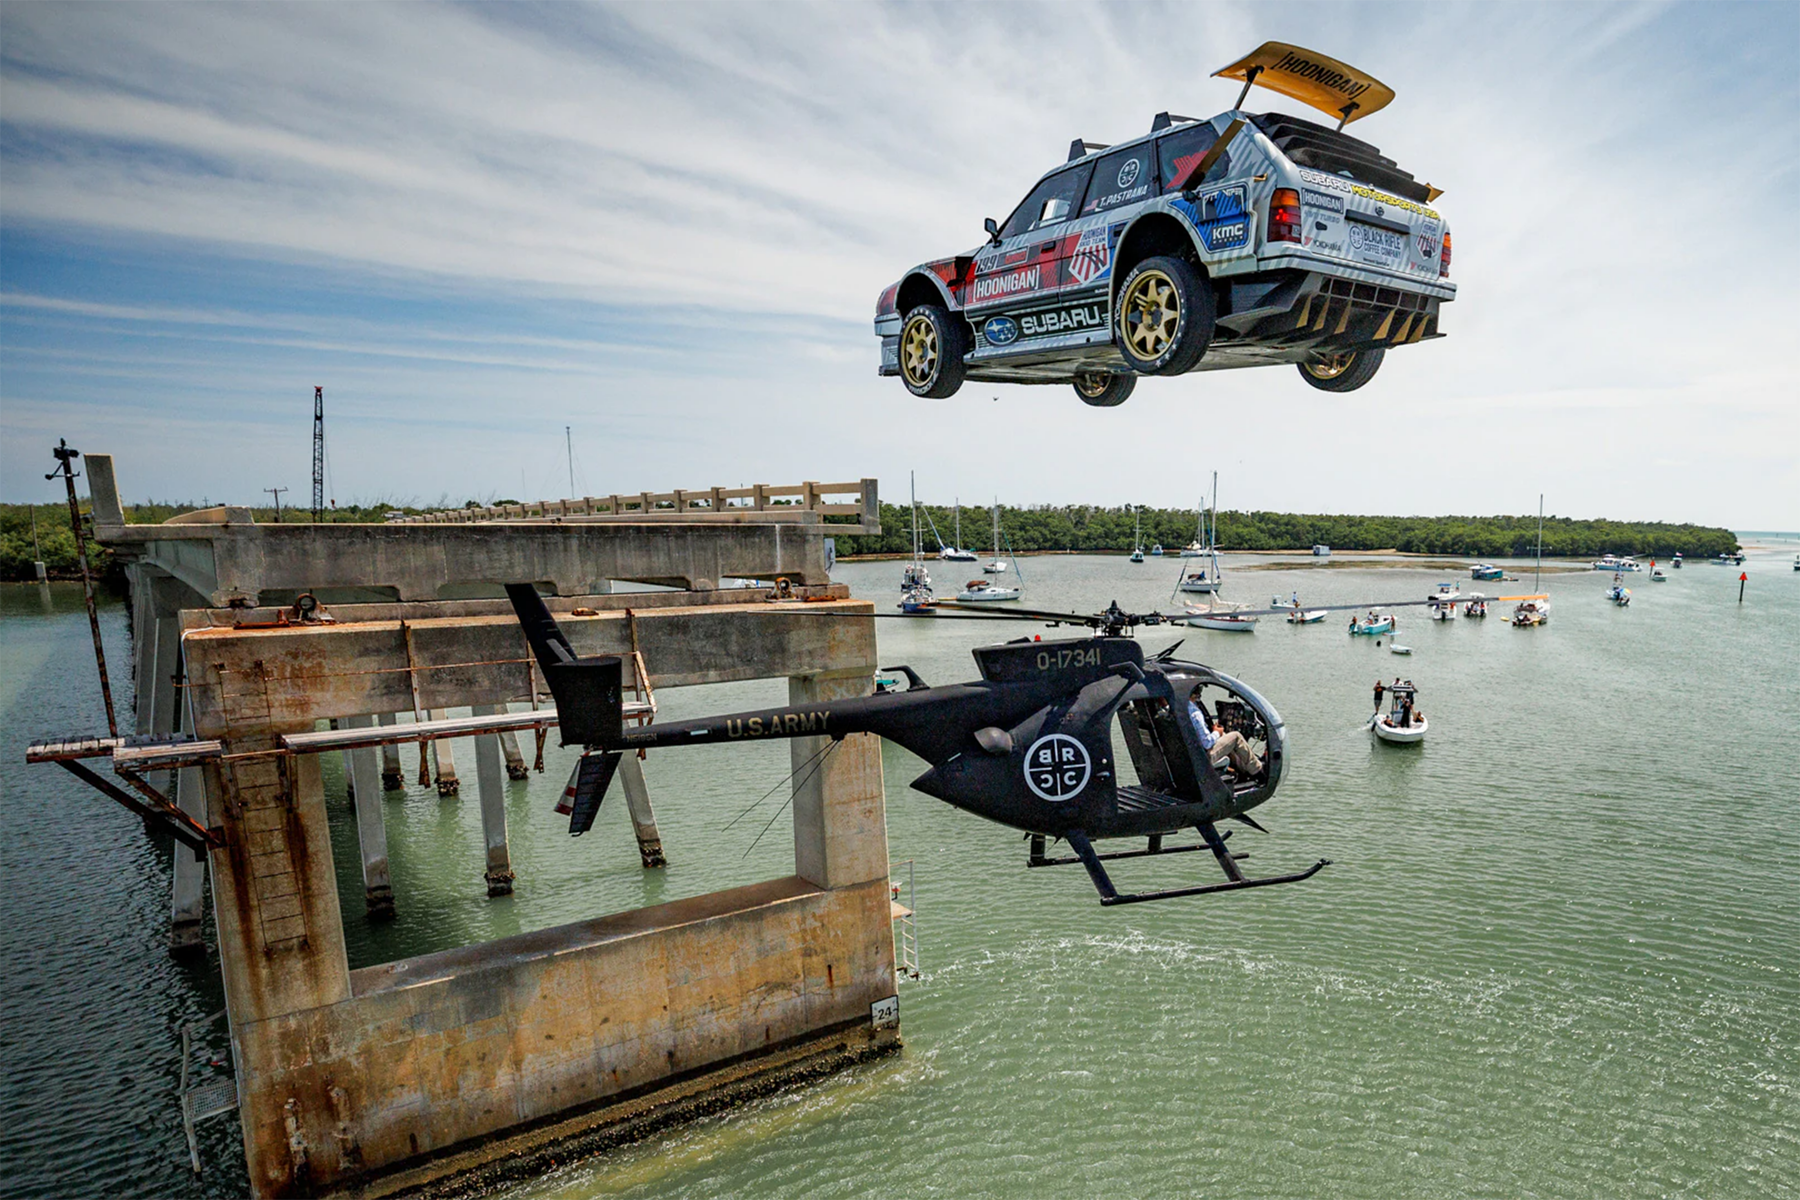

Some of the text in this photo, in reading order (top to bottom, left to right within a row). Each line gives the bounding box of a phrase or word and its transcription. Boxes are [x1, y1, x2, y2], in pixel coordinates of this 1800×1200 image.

[1300, 170, 1351, 193] SUBARU
[1363, 228, 1384, 246] BLACK
[1021, 306, 1101, 335] SUBARU
[878, 1006, 893, 1021] 24
